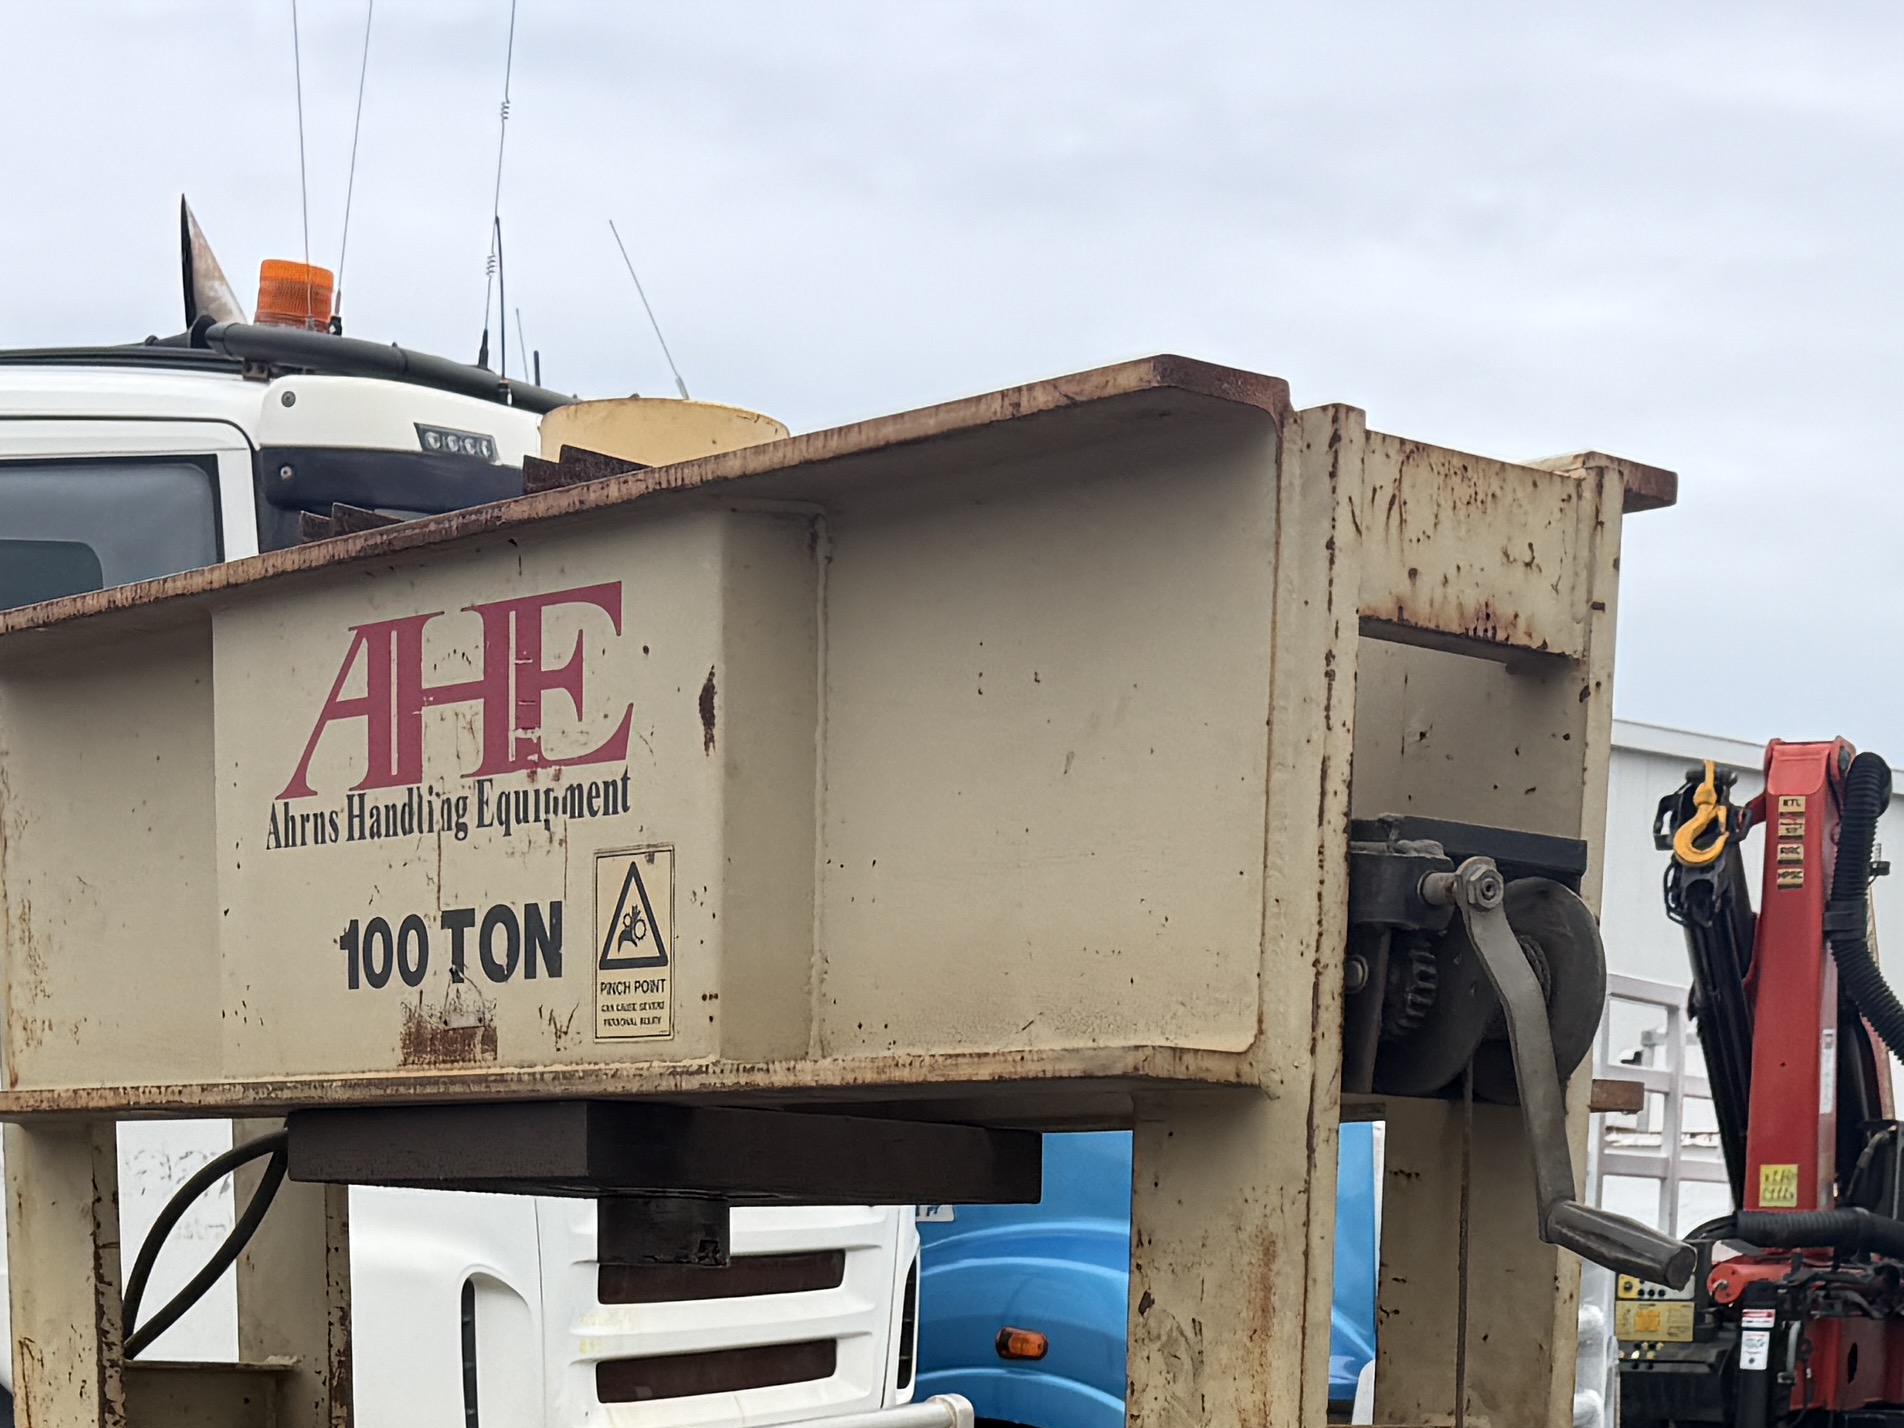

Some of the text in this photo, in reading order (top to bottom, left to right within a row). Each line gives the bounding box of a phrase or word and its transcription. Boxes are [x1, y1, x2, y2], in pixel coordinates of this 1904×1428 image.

[275, 581, 634, 800] AHE
[266, 765, 631, 850] Ahrns Handling Equipment
[339, 900, 563, 989] 100 TON
[600, 978, 666, 996] PINCH POINT
